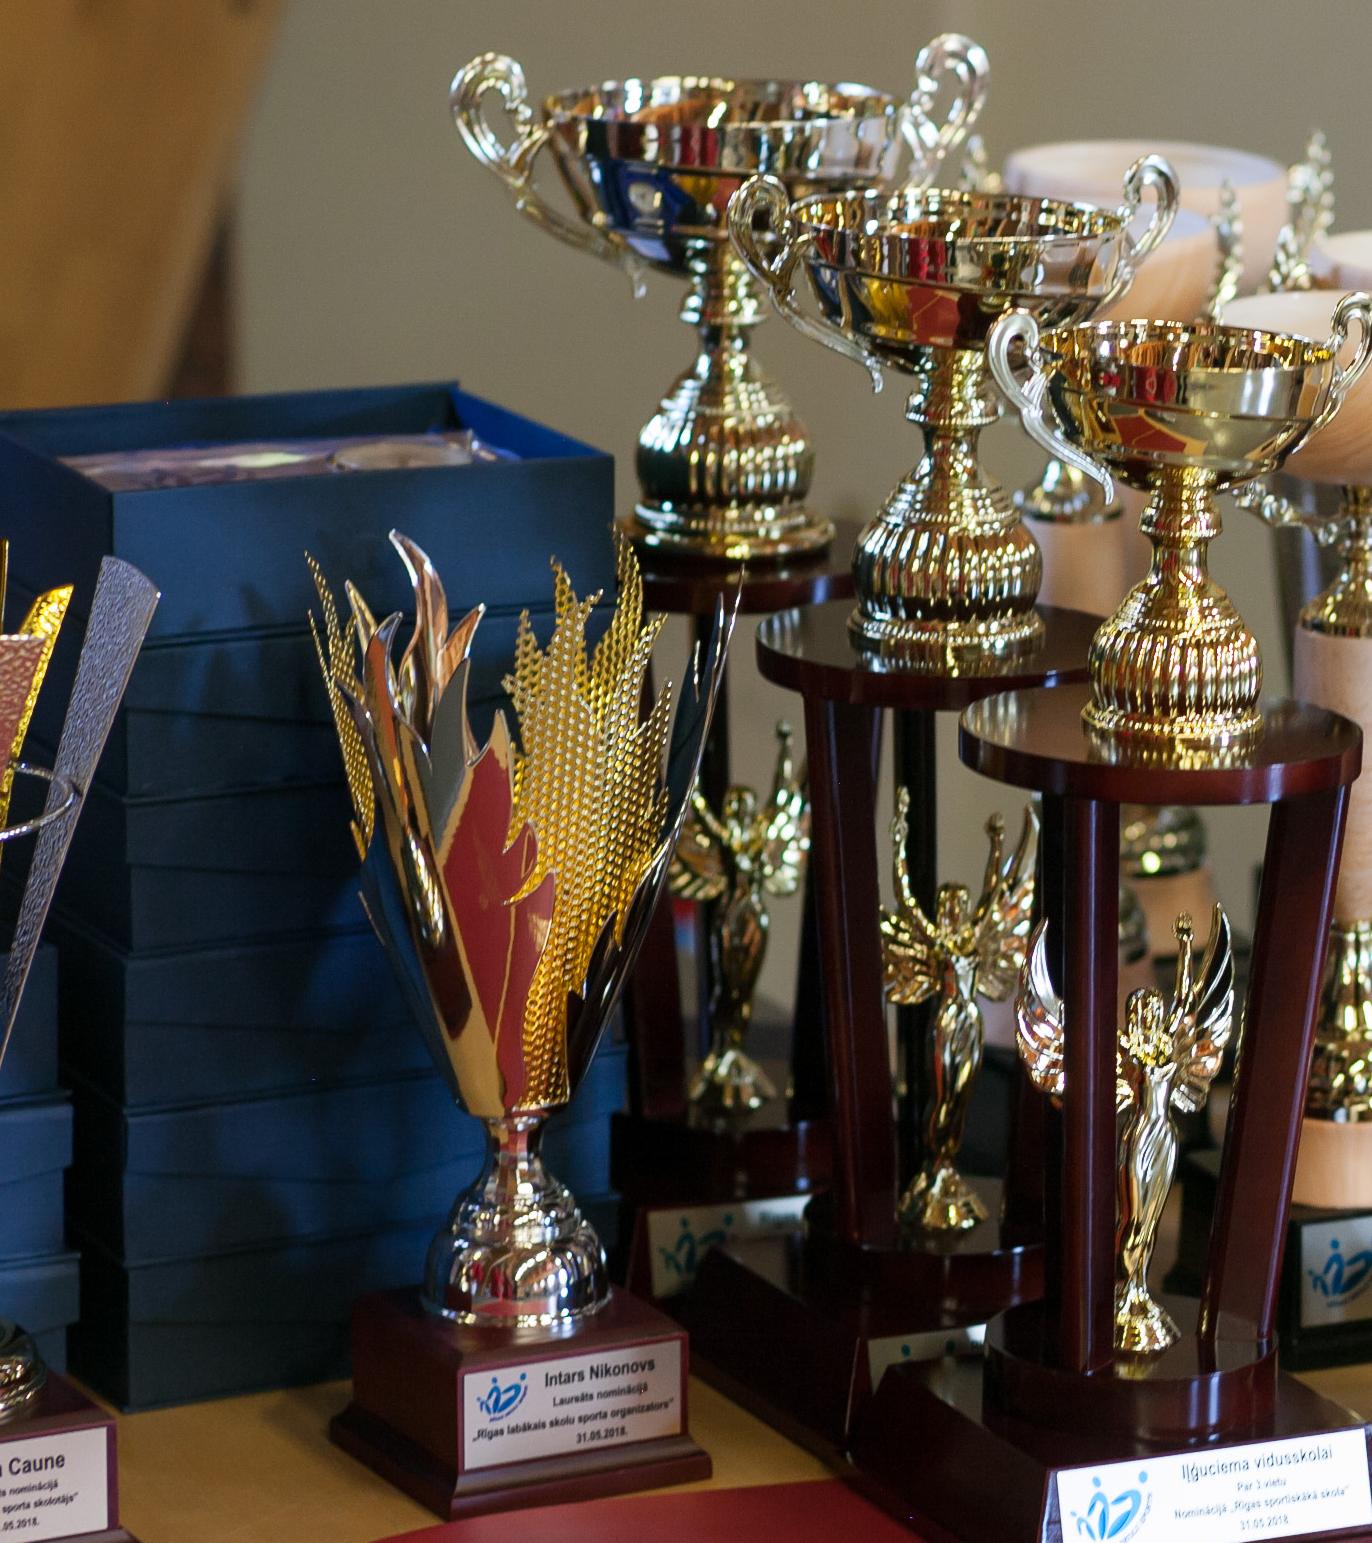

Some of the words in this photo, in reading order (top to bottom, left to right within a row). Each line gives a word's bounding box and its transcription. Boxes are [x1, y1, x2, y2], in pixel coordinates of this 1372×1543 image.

[545, 1369, 585, 1388] Intars
[590, 1359, 655, 1380] Nikonovs
[553, 1391, 594, 1407] Laureāts
[597, 1382, 648, 1399] nominācijā
[507, 1419, 546, 1436] labākais
[577, 1410, 607, 1425] sporta
[9, 1454, 66, 1476] Caune
[1254, 1444, 1333, 1469] vidusskolai
